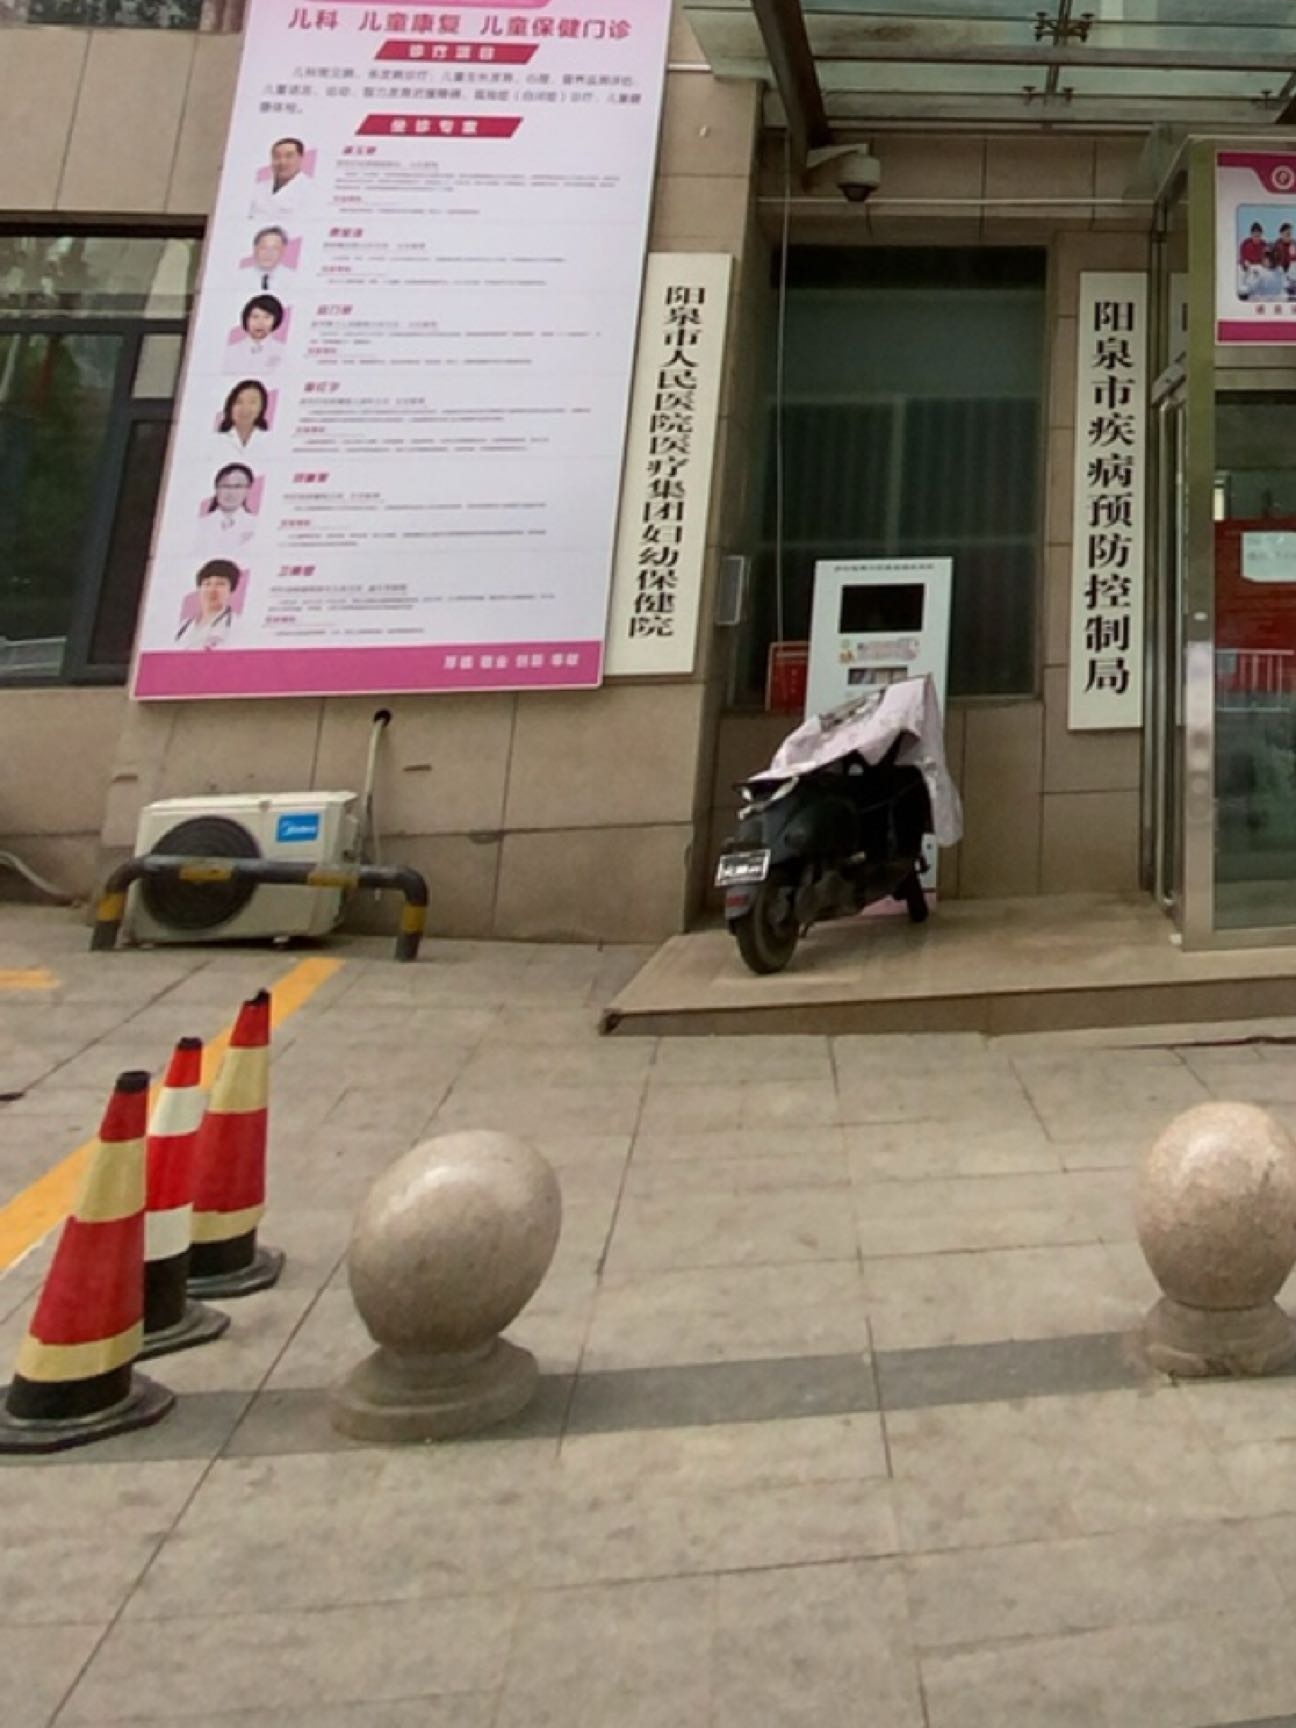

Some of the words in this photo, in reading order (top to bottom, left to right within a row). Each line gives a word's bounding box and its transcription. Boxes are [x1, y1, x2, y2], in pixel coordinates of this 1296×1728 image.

[288, 8, 338, 30] 儿科
[359, 11, 462, 35] 儿童康复
[480, 15, 633, 40] 儿童保健门诊
[628, 285, 706, 638] 阳泉市人民医院医疗集团妇幼保健院
[1084, 301, 1136, 696] 阳泉市疾病预防控制局
